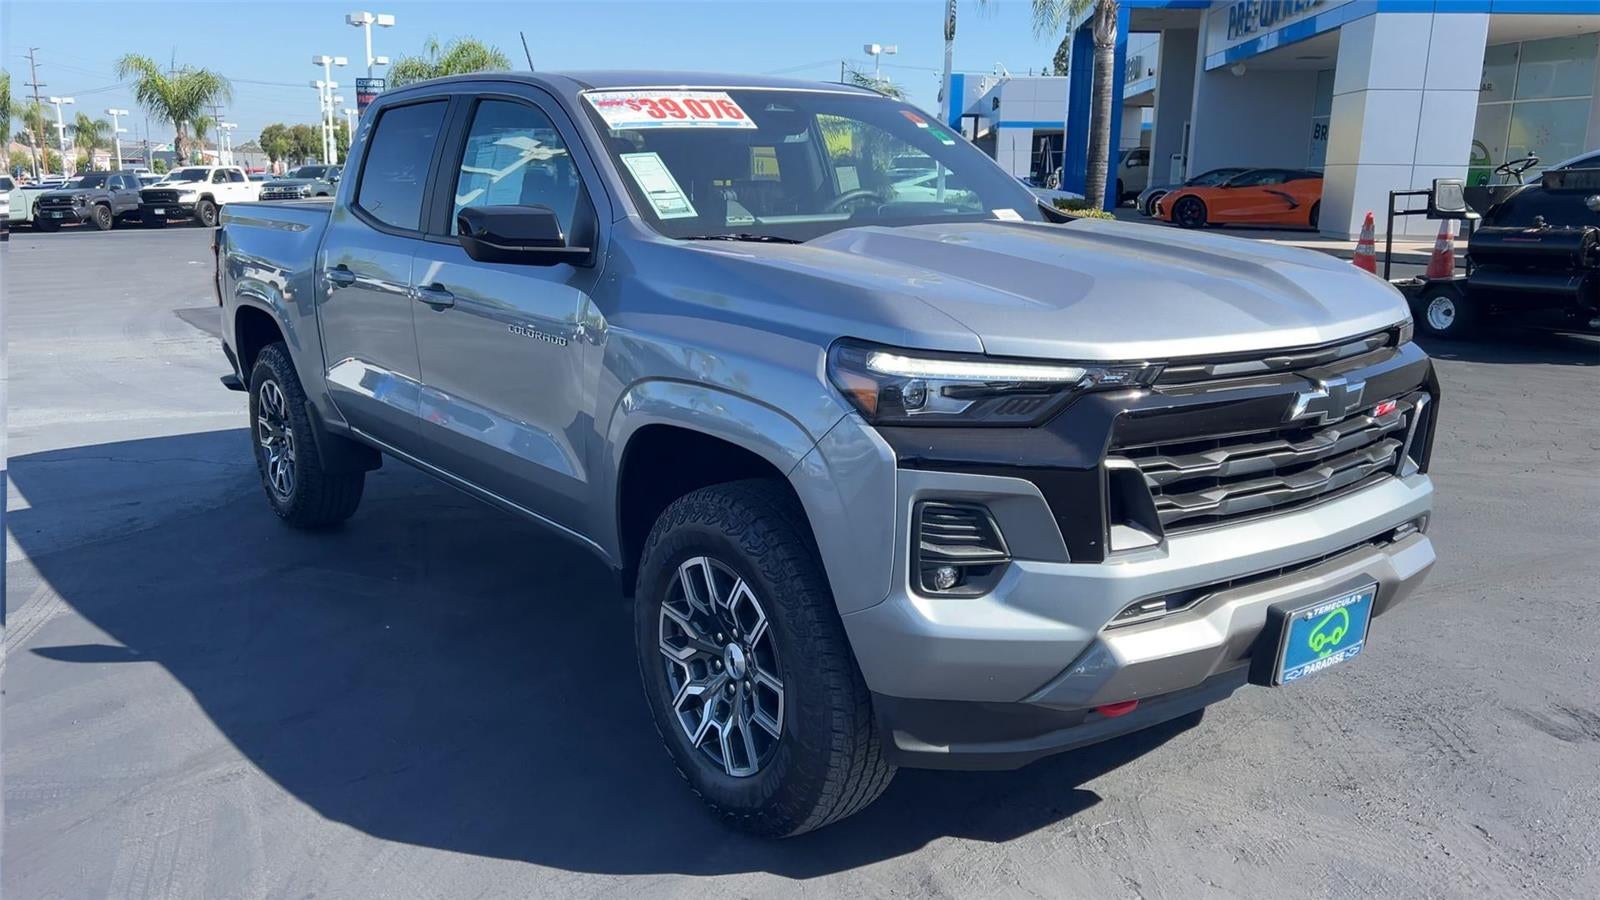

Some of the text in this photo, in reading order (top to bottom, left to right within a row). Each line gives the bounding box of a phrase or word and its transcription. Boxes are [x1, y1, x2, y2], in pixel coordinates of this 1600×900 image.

[1227, 0, 1325, 40] PRE-OWN
[625, 97, 745, 121] $39,076
[508, 324, 568, 347] COLORADO
[1312, 595, 1357, 616] TEMECULA
[1302, 651, 1345, 676] PARADISE
